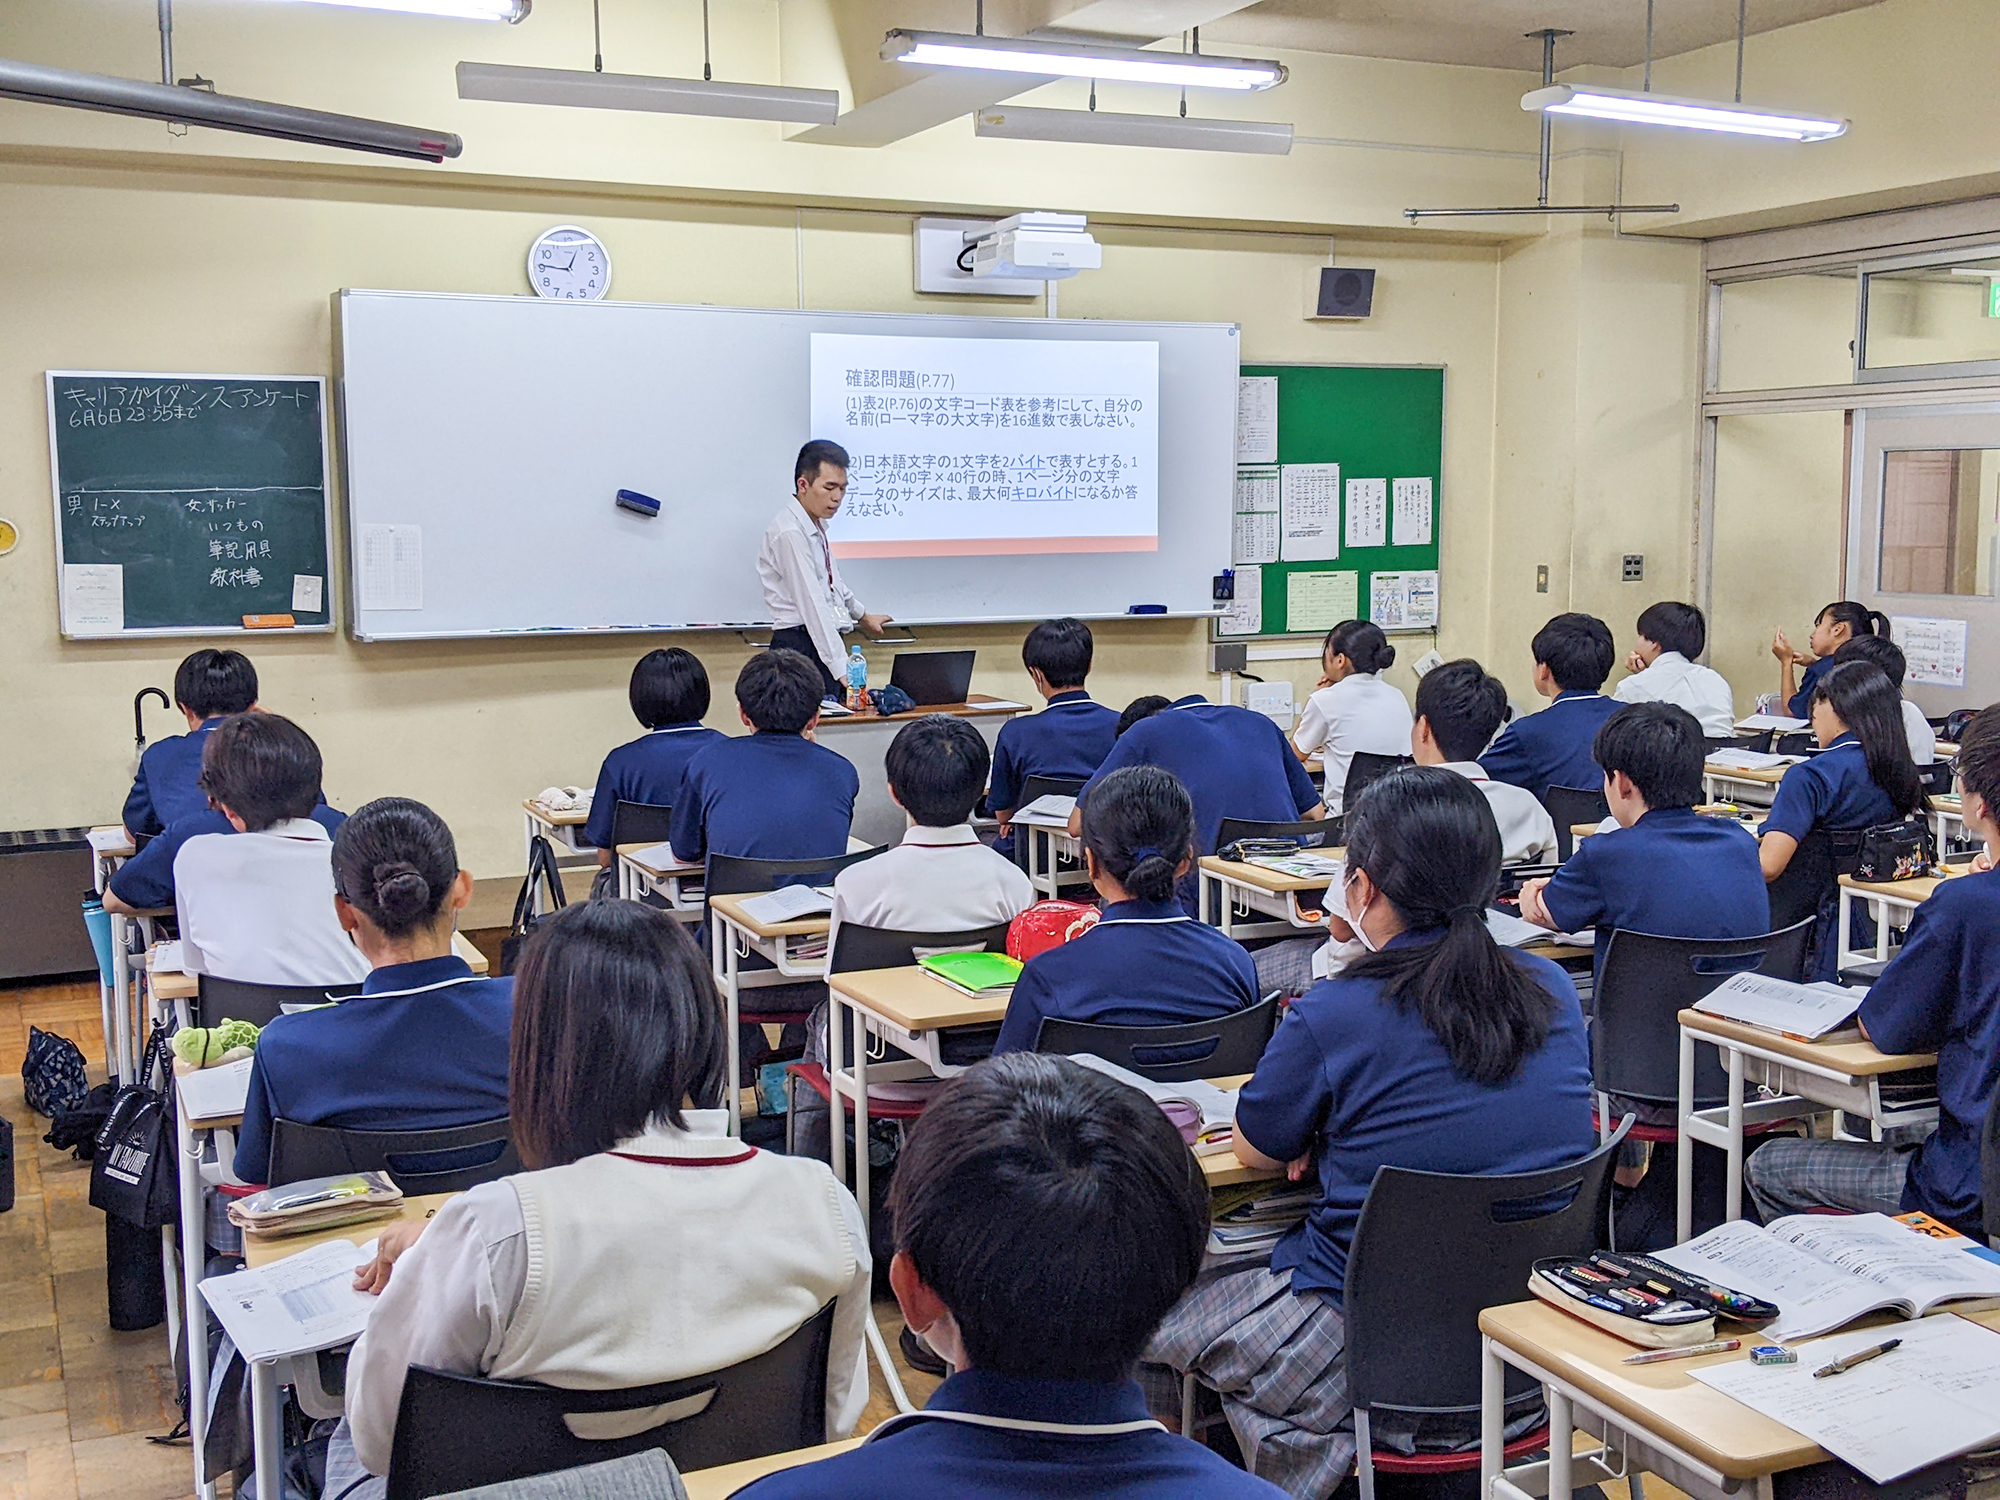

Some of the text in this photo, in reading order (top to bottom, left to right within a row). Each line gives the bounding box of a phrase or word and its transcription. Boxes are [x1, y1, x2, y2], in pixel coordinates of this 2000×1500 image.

[542, 250, 552, 260] 10
[588, 251, 595, 262] 2
[592, 266, 599, 276] 3
[543, 277, 551, 287] 8
[588, 280, 596, 289] 4
[553, 288, 560, 297] 7
[580, 289, 587, 298] 5
[845, 368, 955, 390] 確認問題(P.77)
[845, 395, 1143, 413] (1)表2(P.76)の文字コード表を参考にして、自分の
[845, 411, 1136, 429] 名前(ローマ字の大文字)を16進数で表しなさい。
[849, 453, 1138, 471] 2)日本語文字の1文字を2バイトで表すとする。1
[846, 485, 1138, 501] データのサイズは、最大何キロバイトになるか答
[845, 501, 904, 517] えなさい。
[208, 518, 264, 532] いつもの
[208, 539, 273, 561] 筆記用具
[209, 566, 264, 589] 教科書
